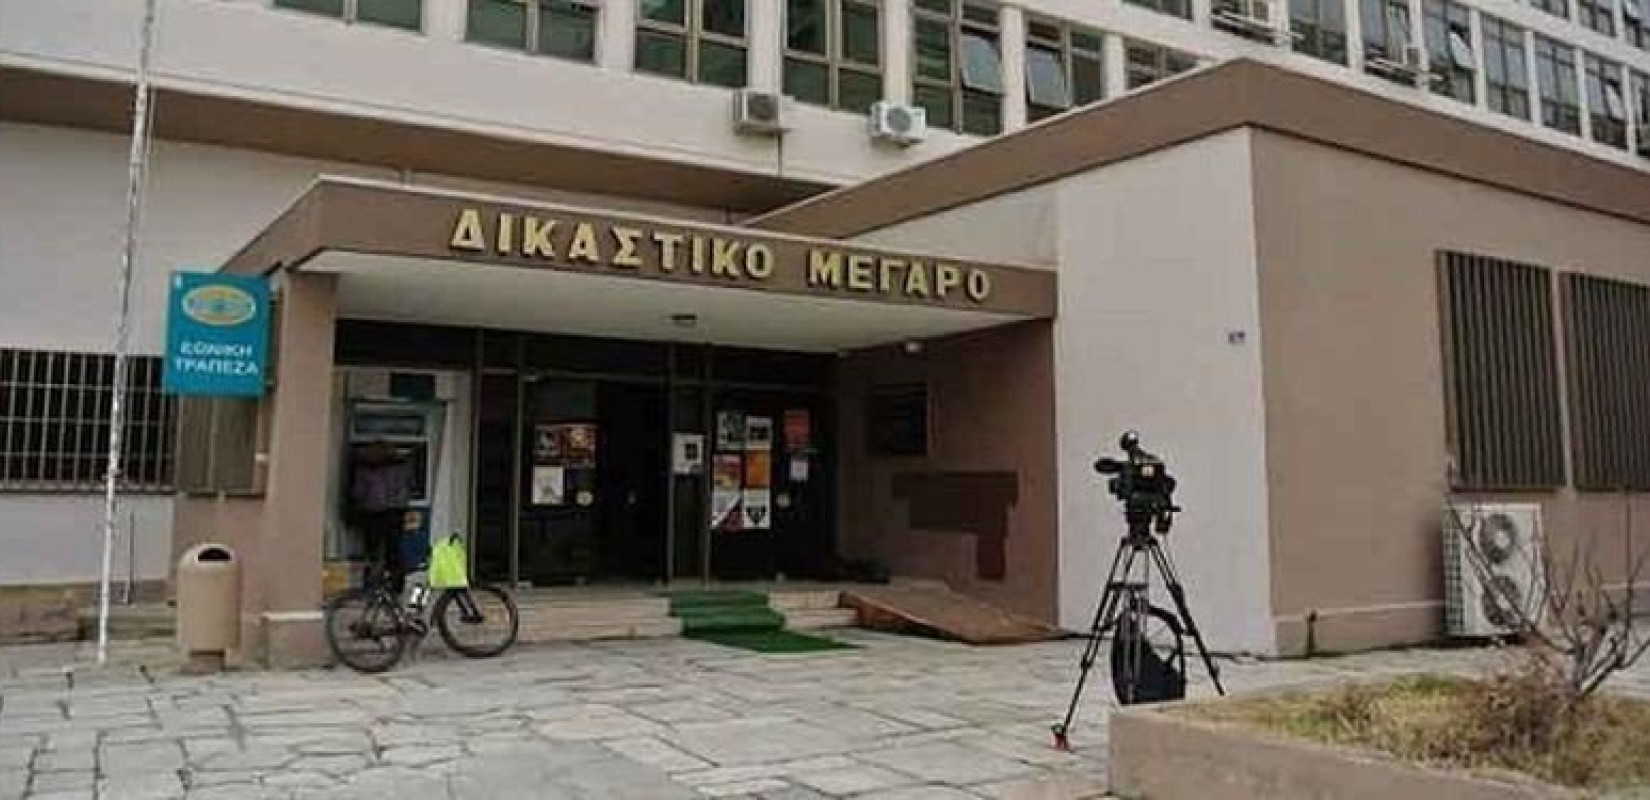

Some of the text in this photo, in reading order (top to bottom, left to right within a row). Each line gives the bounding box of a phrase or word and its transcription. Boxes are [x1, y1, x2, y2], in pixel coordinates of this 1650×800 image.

[450, 207, 993, 301] ΔΙΚΑΣΤΙΚΟ ΜΕΓΑΡΟ
[175, 357, 259, 376] ΤΡΑΠΕΖΑ
